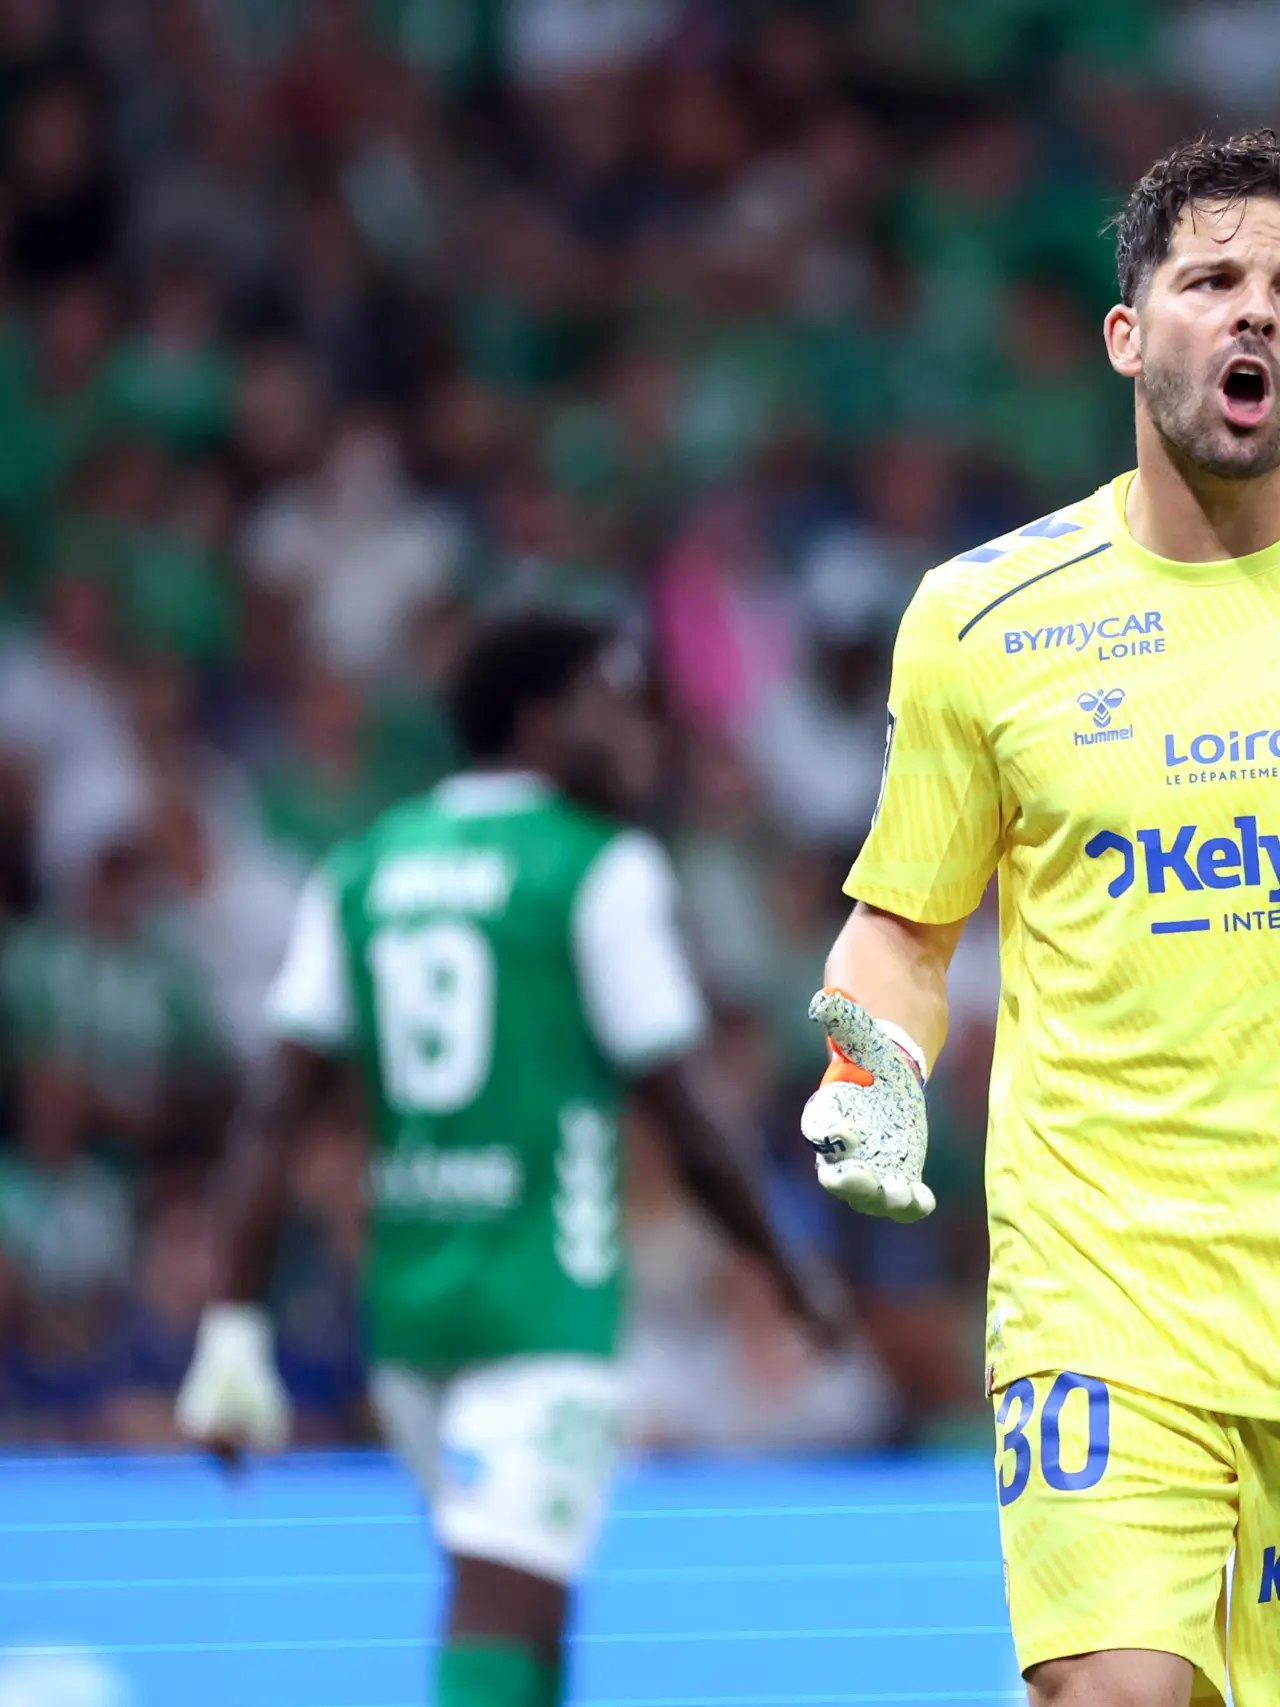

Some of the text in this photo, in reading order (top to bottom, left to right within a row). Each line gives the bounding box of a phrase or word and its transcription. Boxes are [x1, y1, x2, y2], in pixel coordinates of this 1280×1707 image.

[1098, 637, 1166, 661] LOIRE
[1073, 725, 1134, 747] hummel
[1166, 773, 1182, 786] LE
[366, 922, 497, 1115] 19
[996, 1370, 1110, 1507] 30
